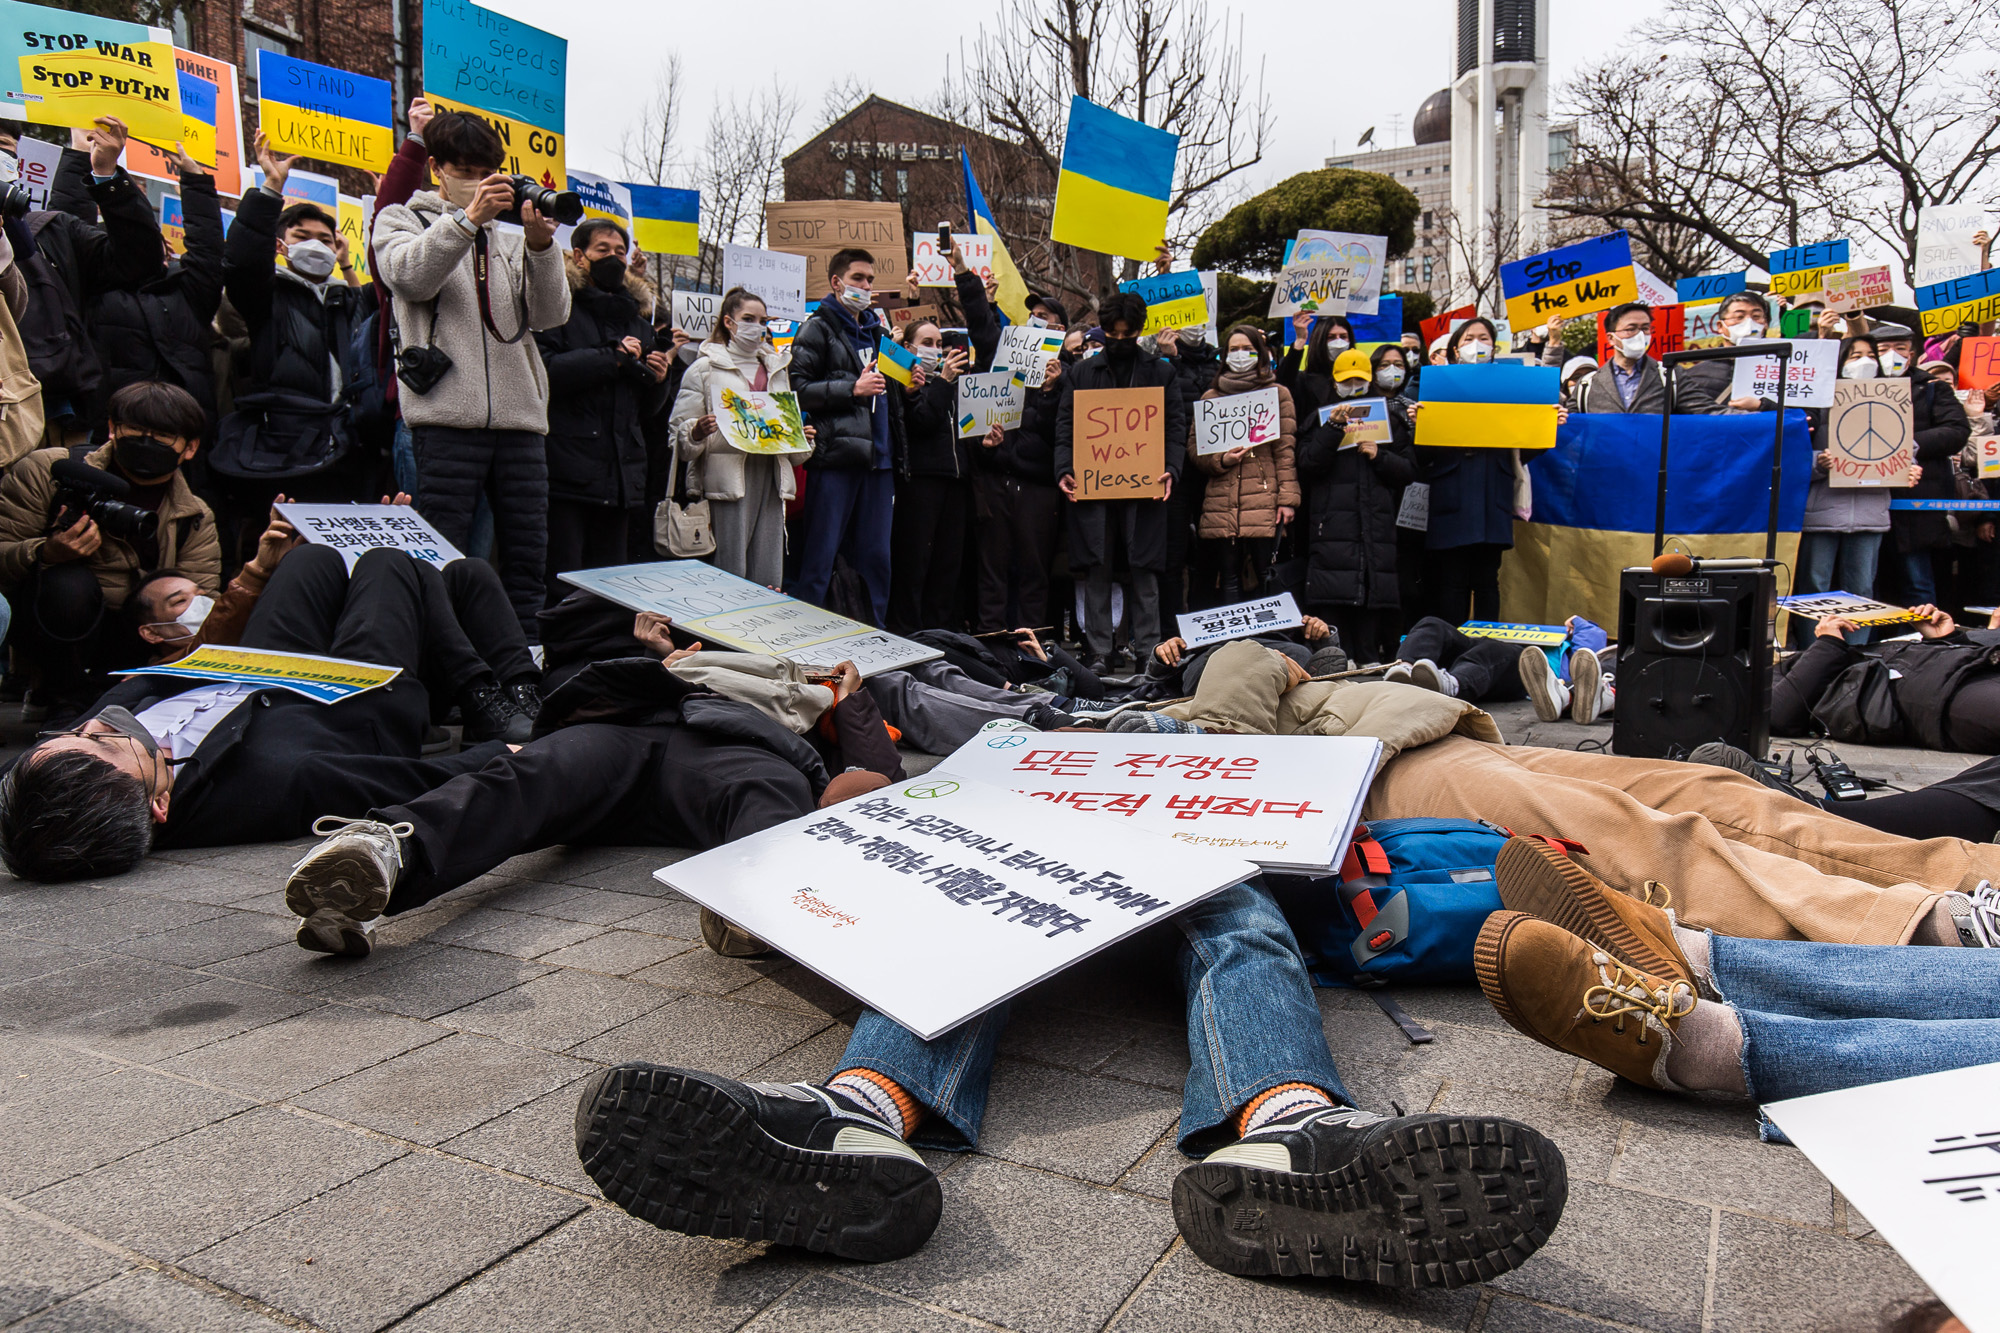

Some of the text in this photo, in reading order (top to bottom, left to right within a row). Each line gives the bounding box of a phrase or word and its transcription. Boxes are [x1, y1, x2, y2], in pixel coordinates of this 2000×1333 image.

[475, 7, 509, 37] the
[23, 31, 153, 68] STOP WAR
[430, 40, 512, 77] in your
[32, 65, 170, 102] STOP PUTIN
[288, 66, 355, 99] STAND
[299, 100, 341, 123] WITH
[278, 118, 374, 163] UKRAINE
[528, 131, 557, 157] GO
[778, 220, 893, 242] STOP PUTIN
[1959, 216, 1983, 229] WAR
[1783, 242, 1841, 270] НЕТ
[1923, 248, 1958, 263] SAVE
[1287, 268, 1317, 281] STAND
[1321, 268, 1350, 277] WITH
[1524, 258, 1582, 288] Stop
[1919, 264, 1980, 282] UKRAINE
[1531, 280, 1621, 313] the War
[1692, 276, 1727, 297] NO
[1830, 284, 1888, 303] GO TO HELL
[1932, 270, 1995, 306] НЕТ
[687, 297, 712, 313] NO
[1856, 293, 1893, 308] PUTIN
[895, 310, 911, 322] NO
[1003, 326, 1041, 352] World
[1787, 366, 1816, 381] 중단
[962, 377, 1012, 399] Stand
[1785, 383, 1814, 398] 철수
[1834, 383, 1913, 414] DIALOGUE
[1086, 405, 1158, 440] STOP
[1202, 400, 1268, 421] Russia
[1207, 418, 1256, 444] STOP
[1833, 448, 1911, 479] NOT WAR
[305, 517, 423, 531] 군사행동 중단
[321, 531, 438, 548] 평화협상 시작
[406, 549, 445, 561] AR
[598, 576, 674, 597] NO
[655, 589, 769, 618] NO Putin
[1192, 600, 1281, 623] 우크라이나에
[704, 615, 770, 638] Stand
[1195, 631, 1227, 642] Peace
[1249, 618, 1292, 631] Ukraine
[1202, 609, 1278, 633] 평화를
[1013, 750, 1259, 780] 모든 전쟁은
[1165, 794, 1323, 820] 범죄다
[849, 797, 1171, 916] 우리는 우크라이나, 러시아 등지에서
[803, 817, 867, 845] 전쟁에
[858, 836, 934, 874] 저항하는
[982, 891, 1091, 938] 지지한다
